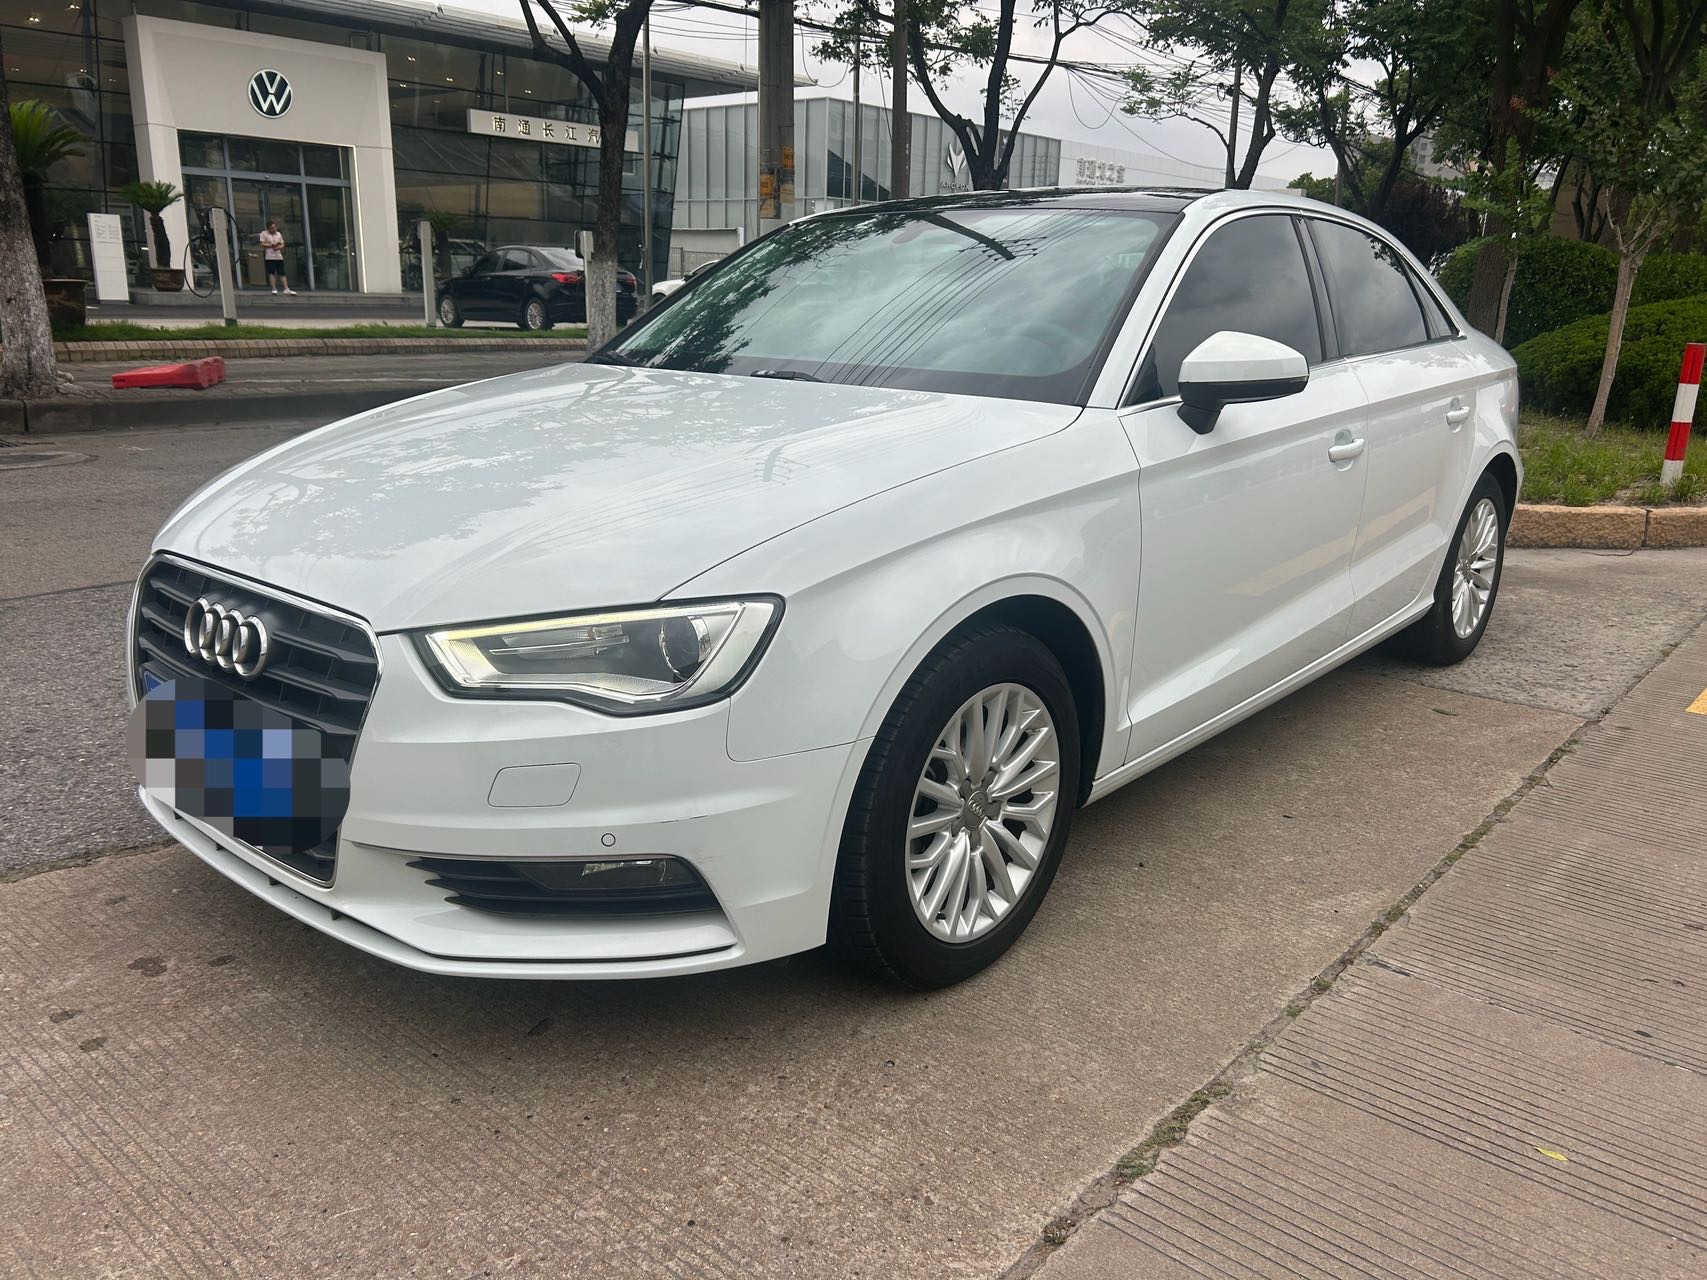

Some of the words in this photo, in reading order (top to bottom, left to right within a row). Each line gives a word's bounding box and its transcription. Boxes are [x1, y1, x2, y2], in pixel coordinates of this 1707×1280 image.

[492, 116, 600, 144] 南通长江汽
